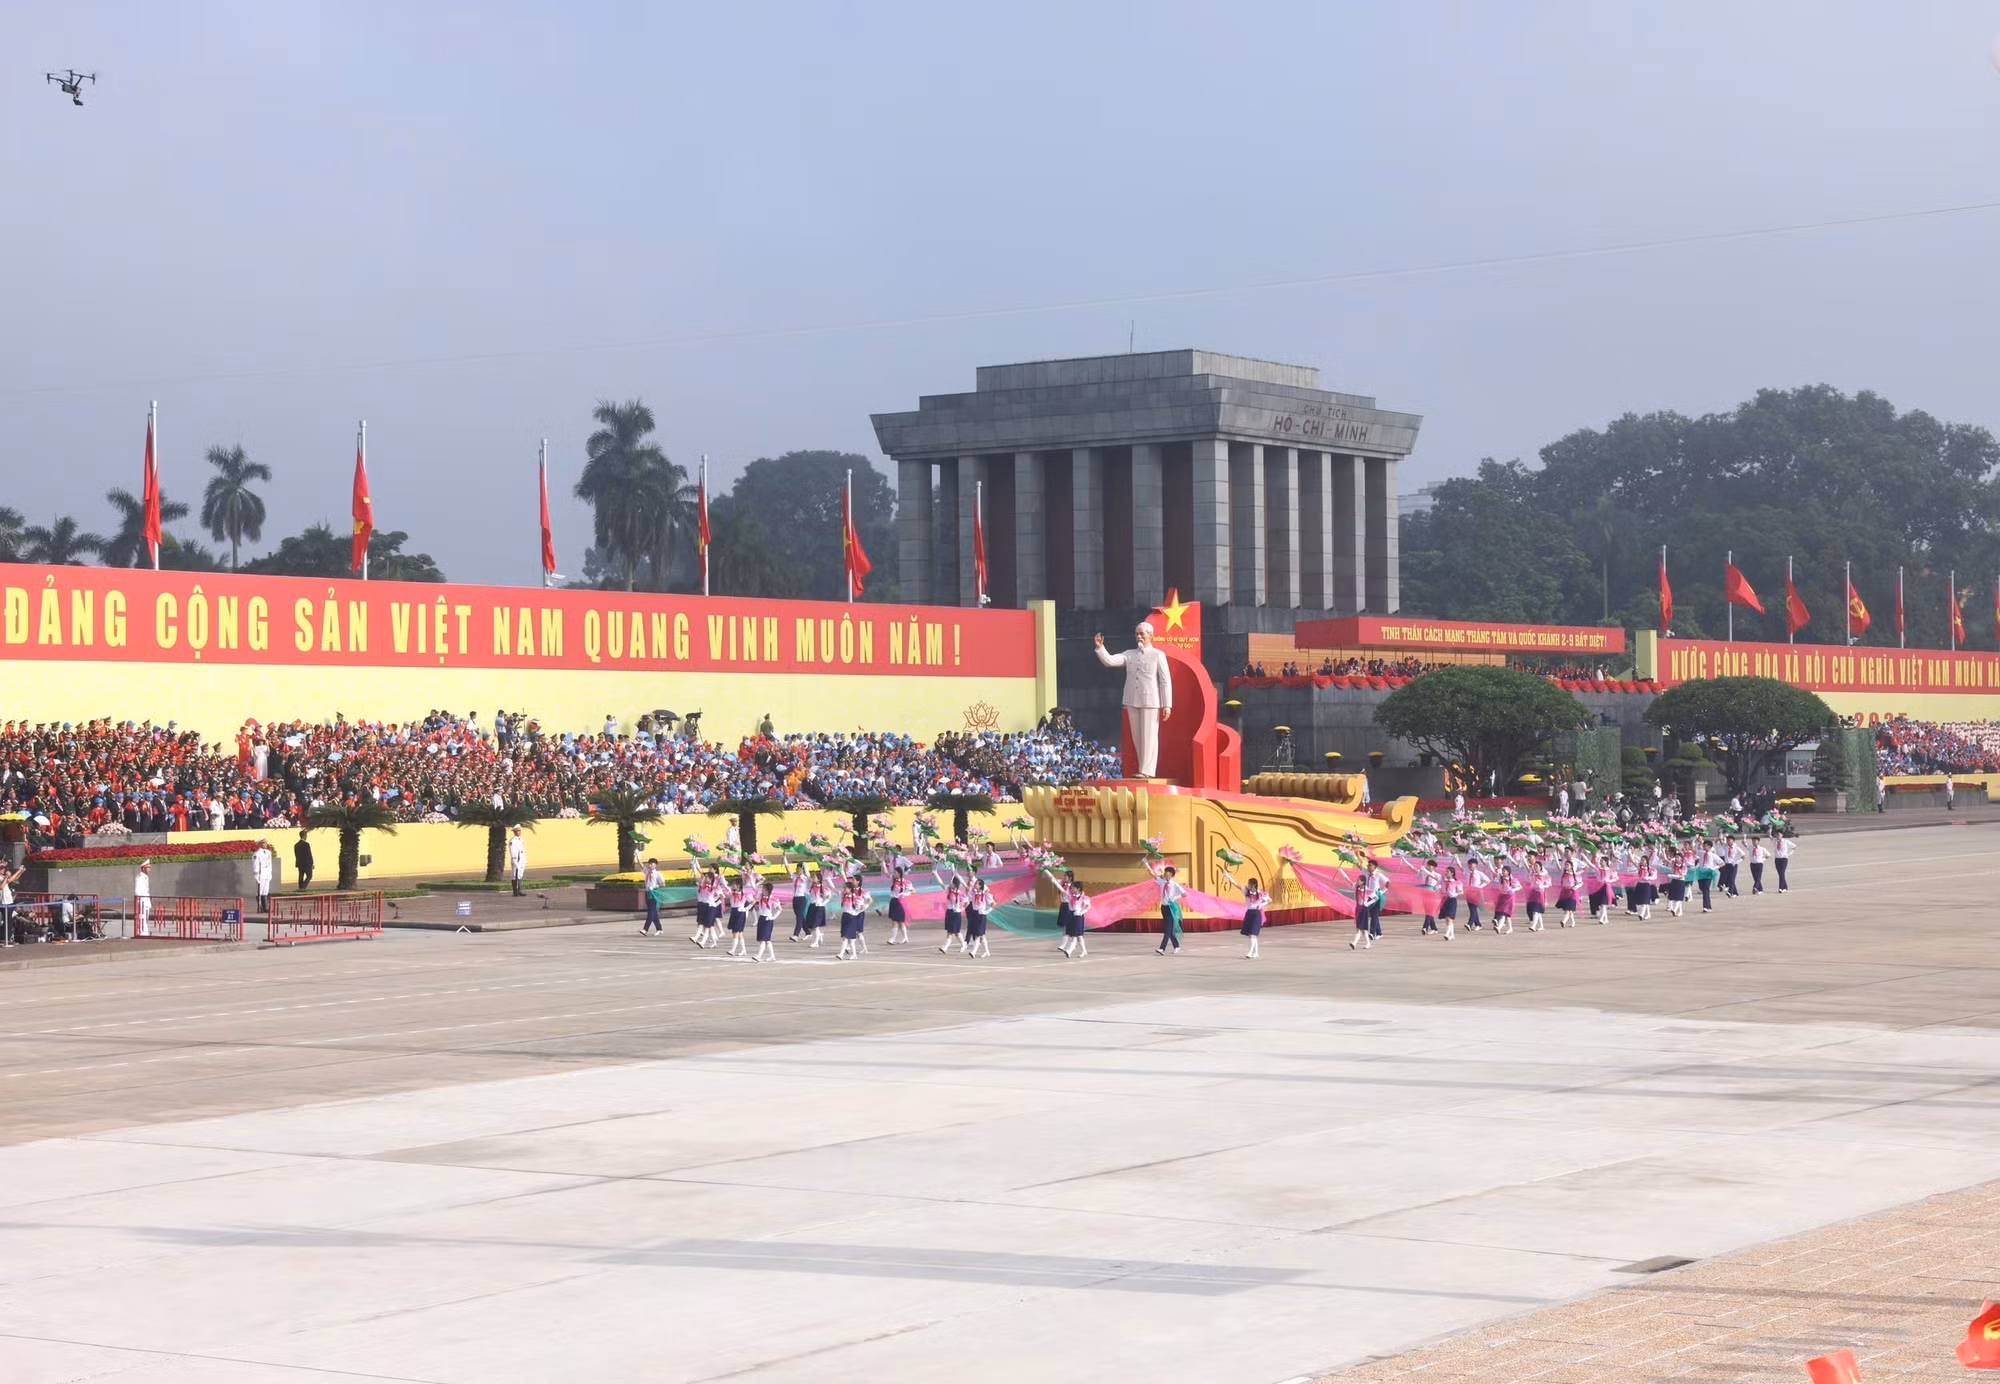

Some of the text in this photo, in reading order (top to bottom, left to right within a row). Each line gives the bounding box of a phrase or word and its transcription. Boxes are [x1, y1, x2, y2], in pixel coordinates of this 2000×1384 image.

[3, 574, 128, 648] ĐẢNG
[155, 584, 269, 660] CỘNG
[294, 586, 369, 653] SẢN
[390, 594, 472, 664] VIỆT
[493, 606, 563, 657] NAM
[584, 609, 689, 663] QUANG
[707, 614, 778, 662] VINH
[795, 612, 873, 664] MUÔN
[889, 615, 943, 666] NĂM
[1381, 626, 1400, 640] TINH
[1445, 628, 1465, 645] MẠNG
[1518, 629, 1537, 646] QUỐC
[1561, 634, 1574, 647] 2-9
[1574, 631, 1588, 647] BẤT
[1755, 648, 1779, 681] HÒA
[1785, 650, 1800, 684] XÃ
[1805, 650, 1826, 689] HỘI
[1831, 650, 1855, 685] CHỦ
[1860, 653, 1895, 686] NGHĨA
[1899, 653, 1923, 691] VIỆT
[1928, 659, 1950, 687] NAM
[1954, 656, 1983, 687] MUÔN
